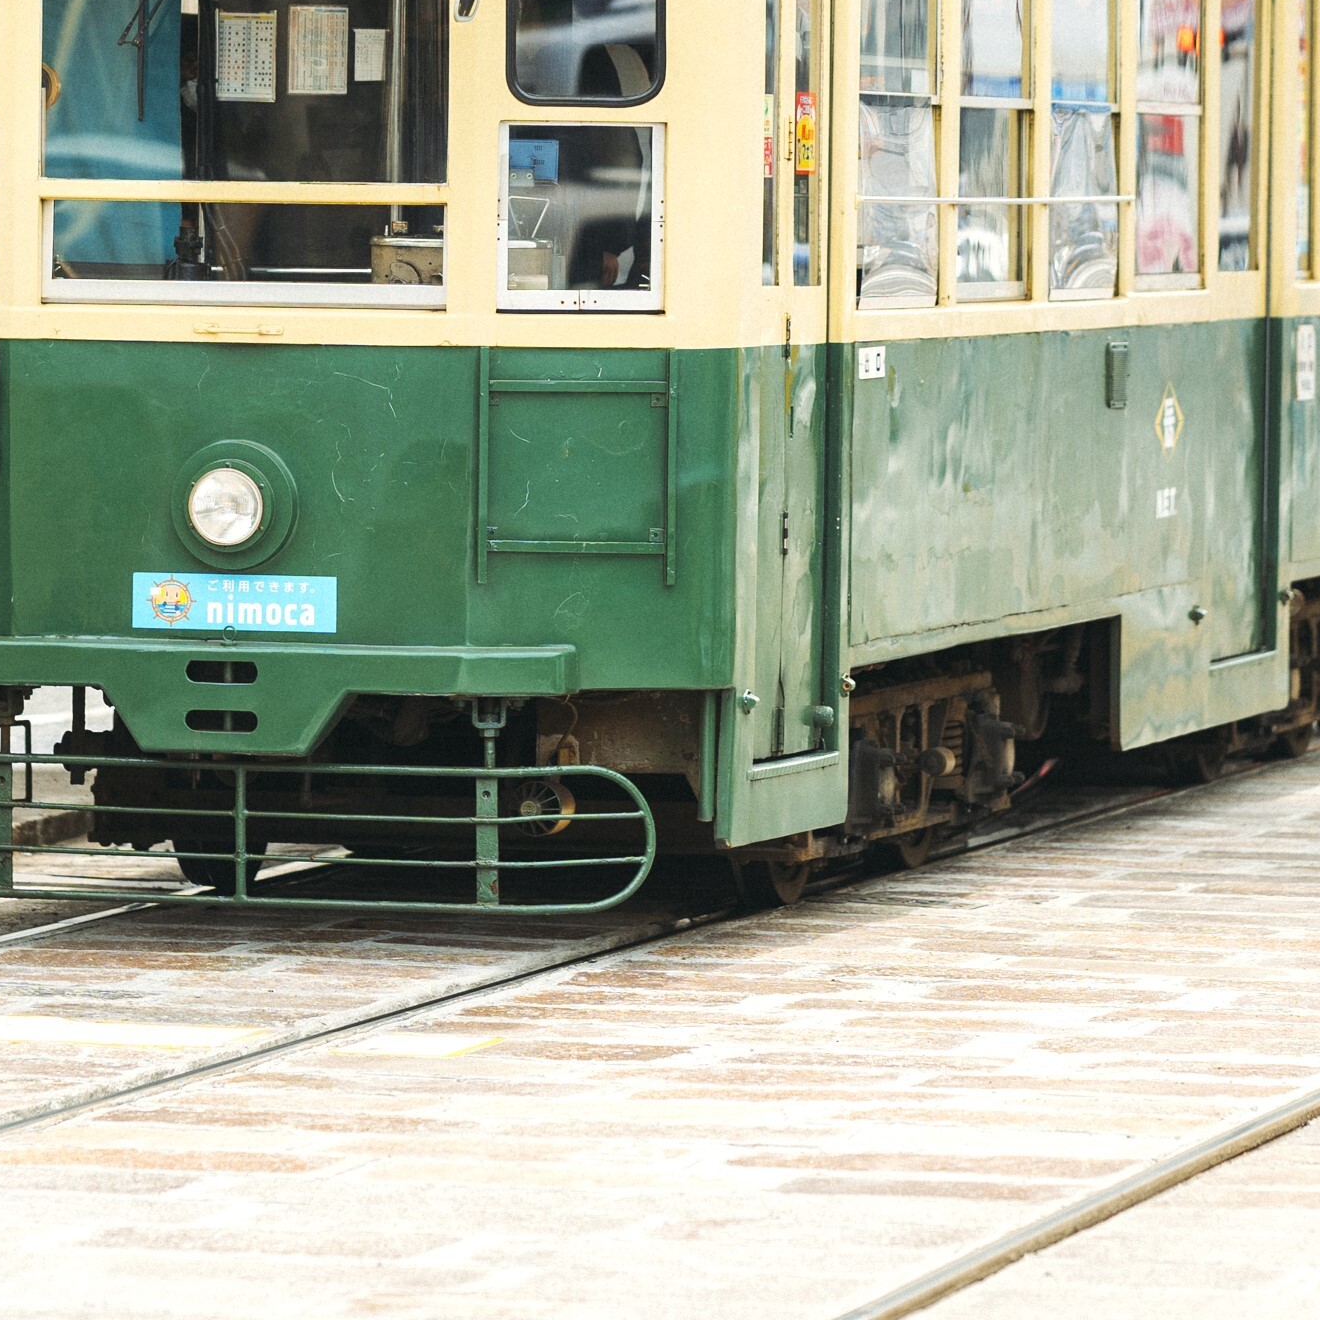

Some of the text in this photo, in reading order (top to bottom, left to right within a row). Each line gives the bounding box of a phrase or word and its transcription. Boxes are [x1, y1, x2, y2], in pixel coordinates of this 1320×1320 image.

[207, 579, 316, 595] ご利用できます。
[207, 594, 315, 626] nimoca
